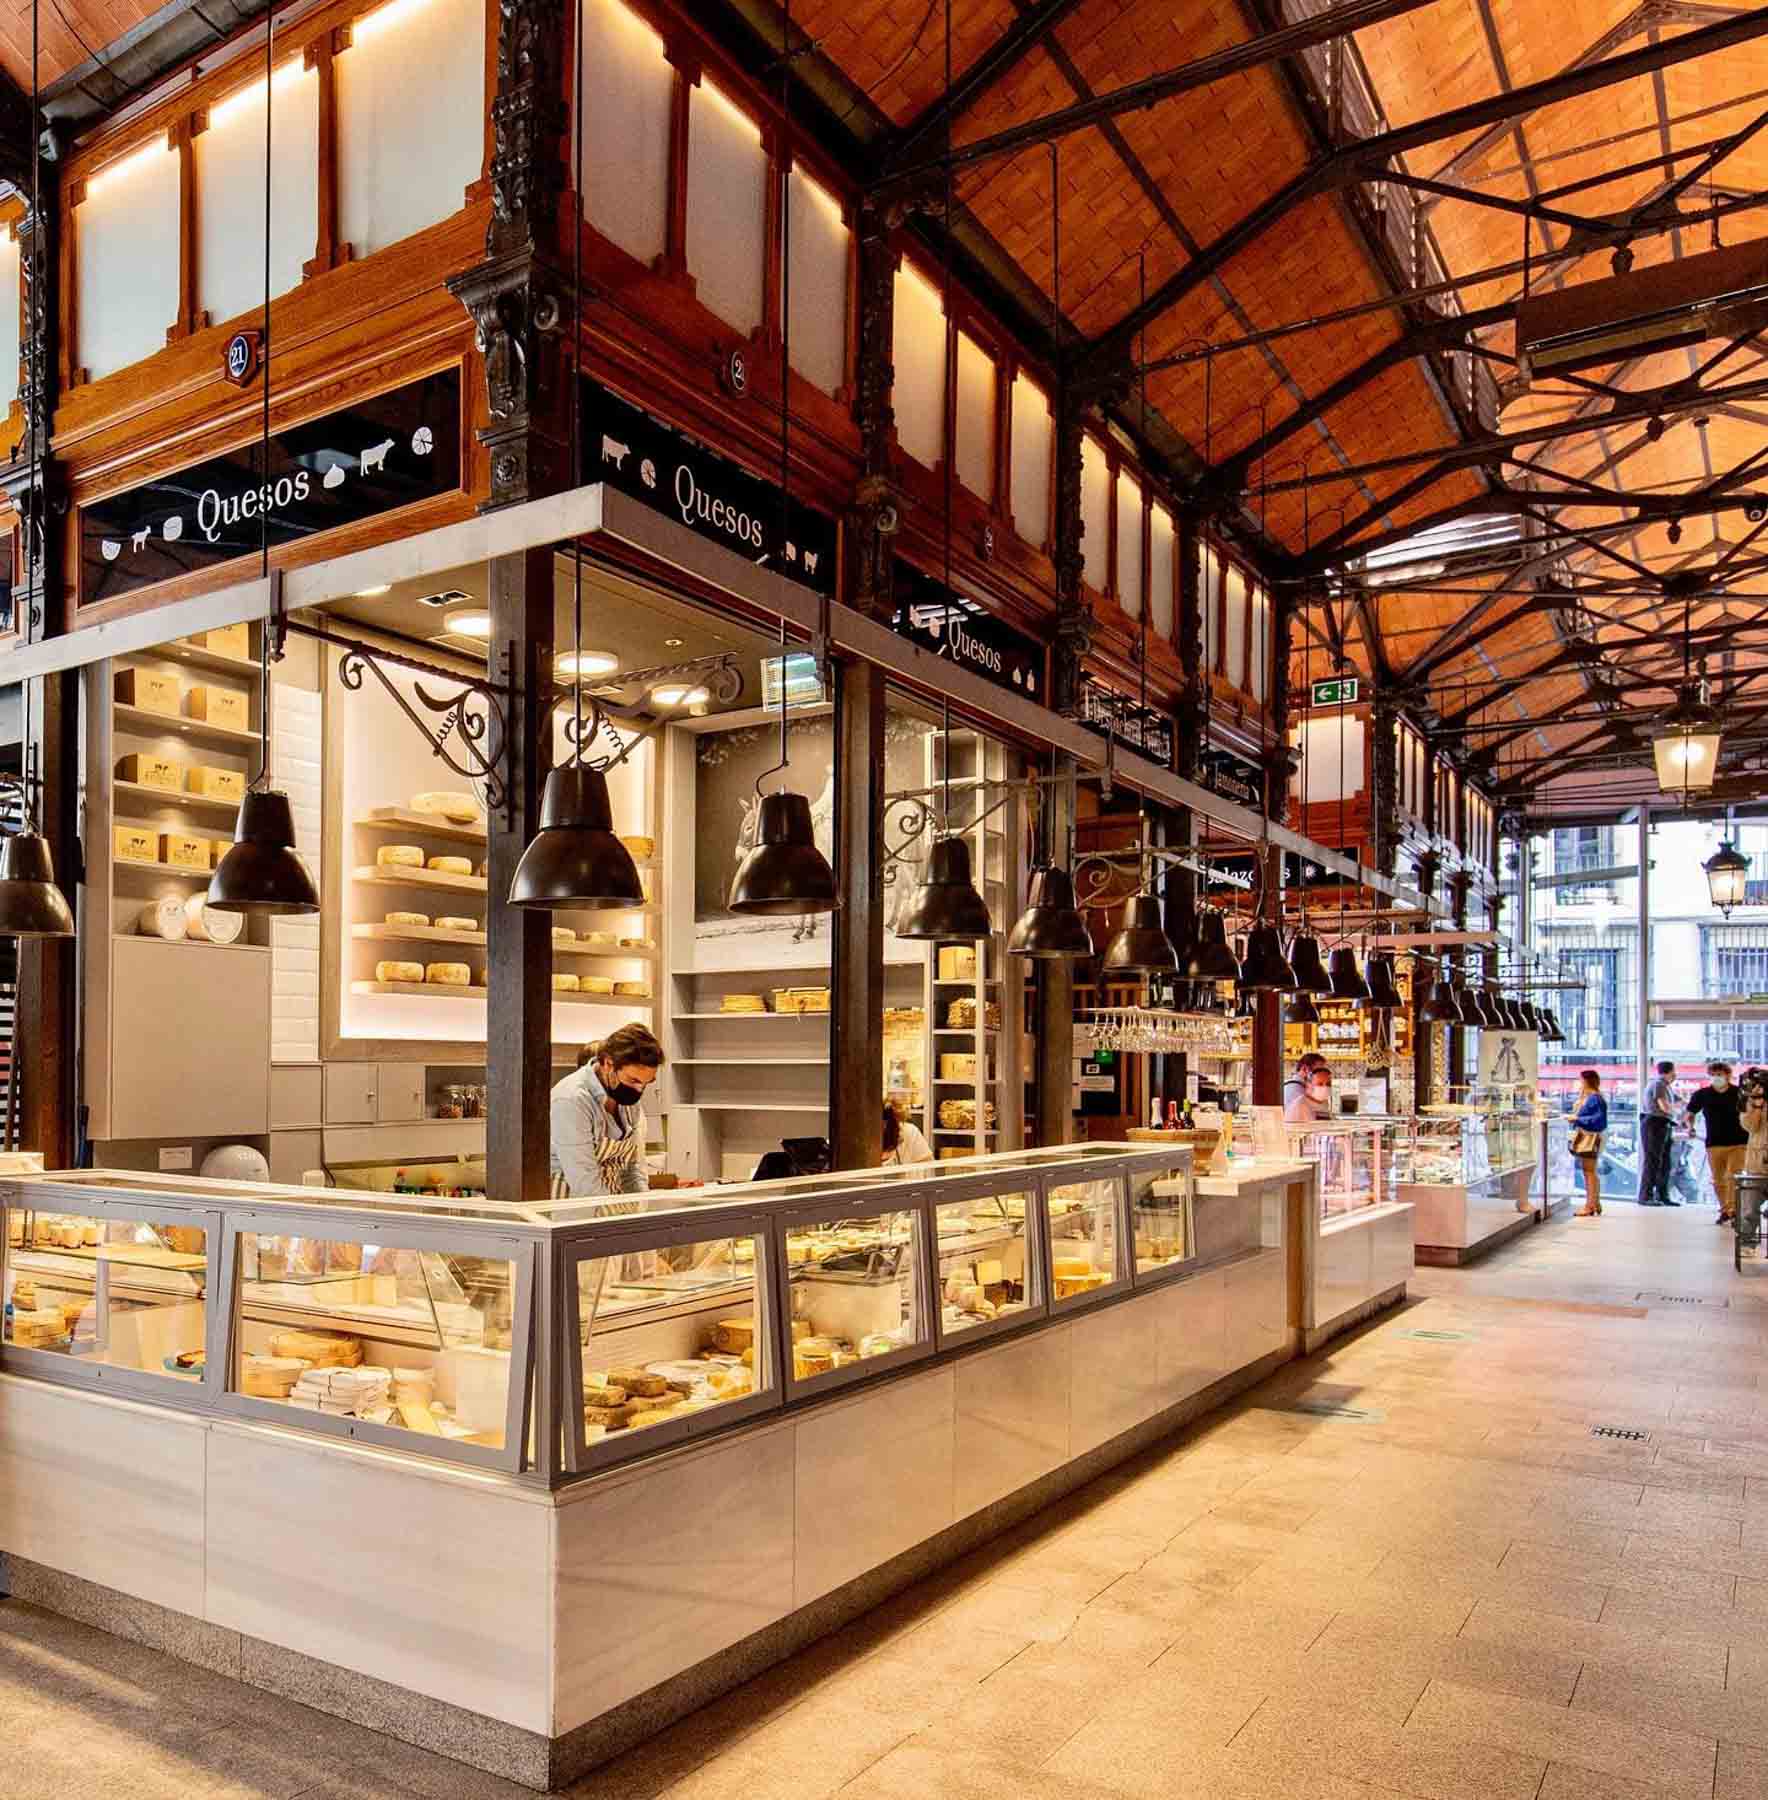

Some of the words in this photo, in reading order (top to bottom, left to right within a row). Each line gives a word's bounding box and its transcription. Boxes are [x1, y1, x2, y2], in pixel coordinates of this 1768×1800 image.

[231, 345, 244, 367] 21
[197, 471, 310, 542] Quesos
[675, 465, 762, 547] Quesos
[949, 617, 1001, 672] Quesos
